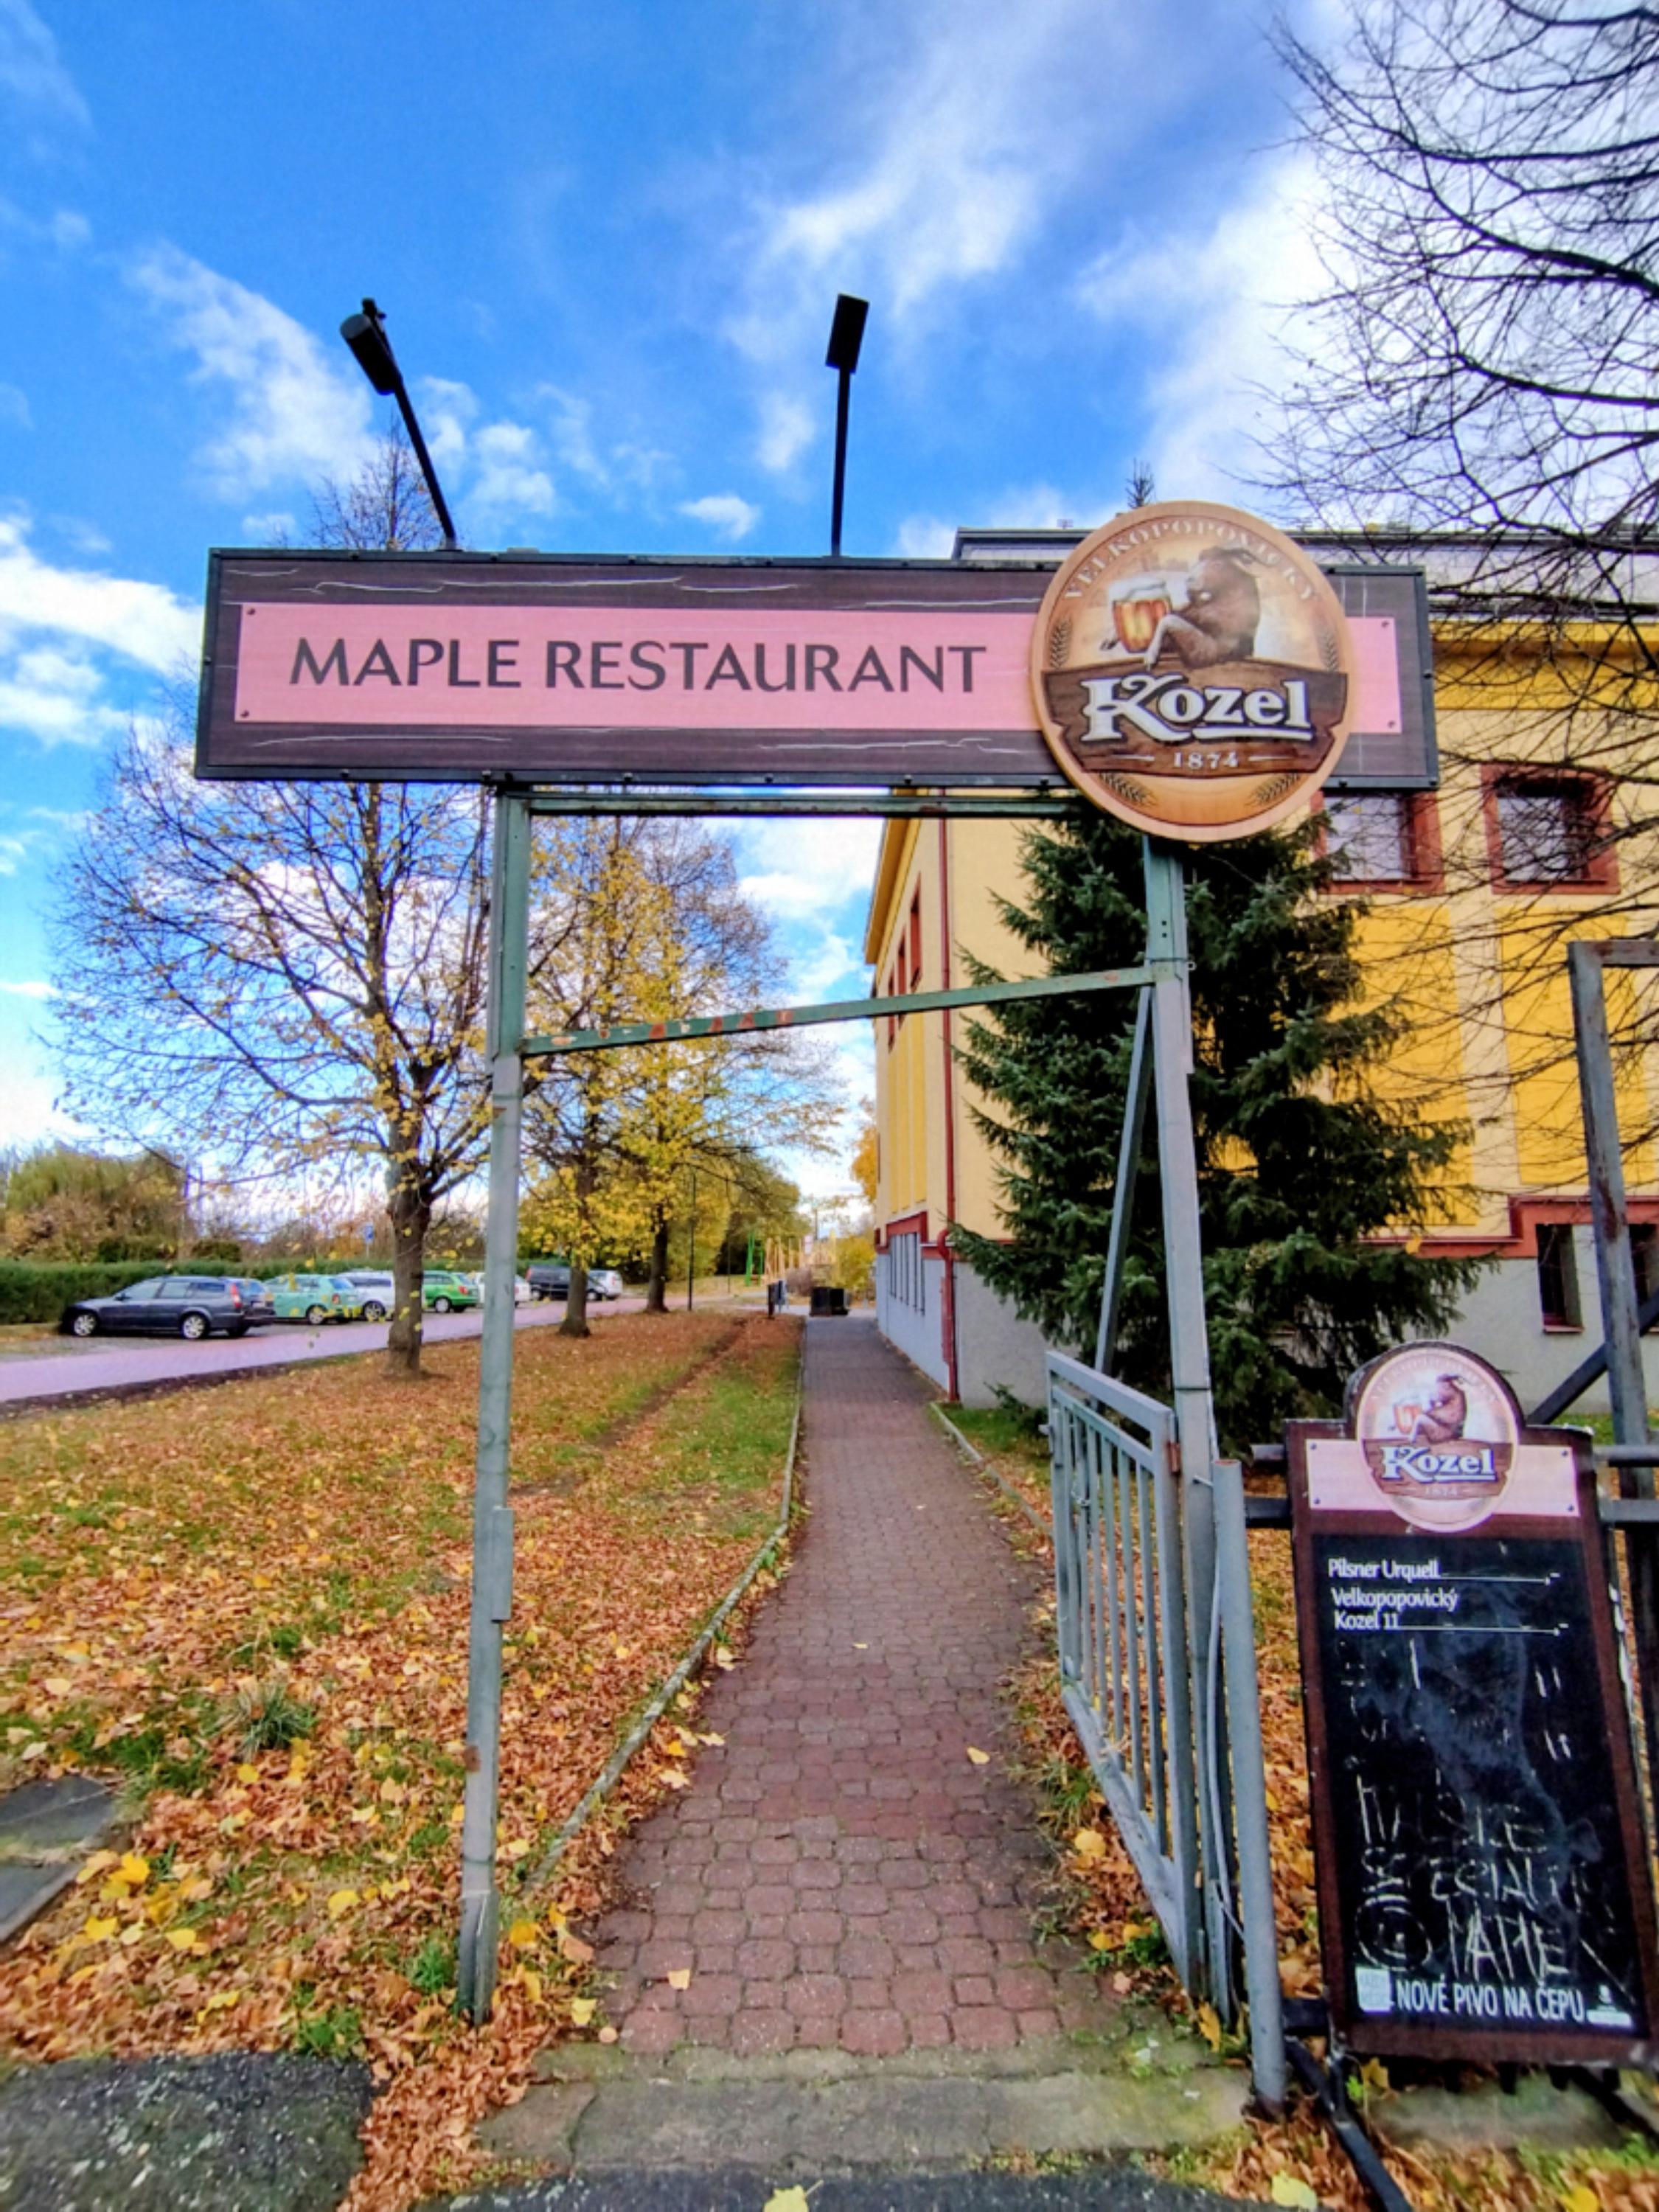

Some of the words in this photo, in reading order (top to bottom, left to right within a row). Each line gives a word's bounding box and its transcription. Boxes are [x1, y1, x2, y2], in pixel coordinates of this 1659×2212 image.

[290, 637, 521, 688] MAPLE
[545, 639, 987, 693] RESTAURANT
[1080, 673, 1313, 742] Kozel
[1173, 752, 1239, 768] 1874
[1380, 1445, 1498, 1484] Kozel
[1329, 1557, 1380, 1578] Pilsner
[1381, 1557, 1441, 1584] Urquell
[1331, 1587, 1459, 1613] Velkopopovický
[1334, 1609, 1380, 1630] Kozel
[1382, 1610, 1400, 1630] 11
[1396, 1974, 1449, 2014] NOVÉ
[1453, 1983, 1498, 2017] PIVO
[1504, 1986, 1534, 2019] NA
[1535, 1980, 1585, 2023] ČEPU
